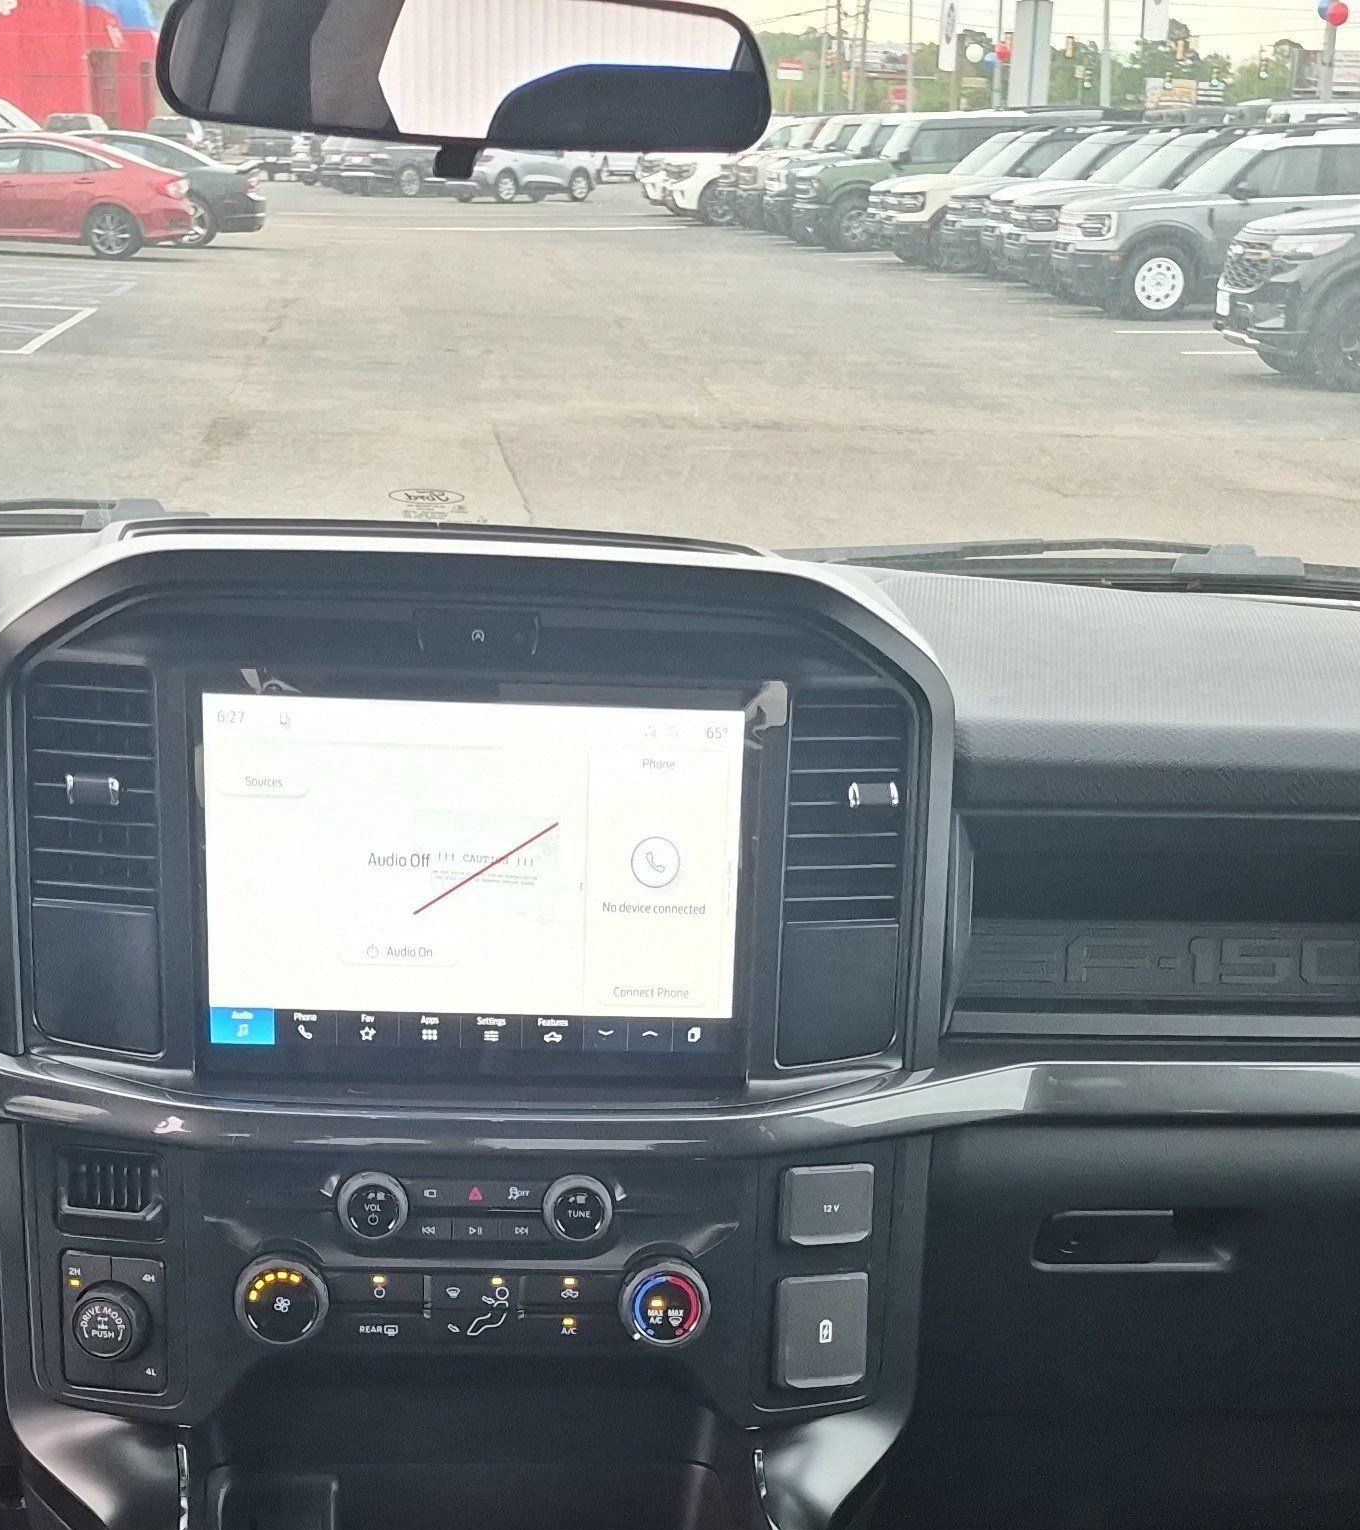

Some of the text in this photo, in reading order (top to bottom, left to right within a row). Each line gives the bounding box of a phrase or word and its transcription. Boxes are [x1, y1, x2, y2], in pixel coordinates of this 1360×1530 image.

[217, 710, 245, 724] 6:27
[706, 727, 729, 740] 65°
[642, 758, 676, 770] Phone
[245, 775, 283, 788] Sources
[368, 853, 431, 868] Audio Off
[602, 901, 706, 915] No device connected
[386, 946, 433, 958] Audio On
[613, 986, 690, 999] Connect Phone
[231, 1010, 254, 1020] Audio
[293, 1011, 318, 1022] Phone
[360, 1013, 375, 1023] Fav
[420, 1015, 440, 1026] Apps
[476, 1016, 507, 1028] Settings
[537, 1017, 569, 1028] Features
[364, 1203, 382, 1212] VOL
[823, 1204, 840, 1213] 12 V
[567, 1209, 591, 1218] TUNE
[68, 1267, 81, 1276] 2H
[142, 1273, 155, 1283] 4H
[80, 1306, 126, 1330] DRIVE MODE
[647, 1309, 663, 1317] MAX
[667, 1309, 684, 1317] MAX
[649, 1317, 663, 1325] A/C
[91, 1329, 115, 1339] PUSH
[359, 1325, 383, 1334] REAR
[561, 1327, 578, 1335] A/C
[145, 1367, 156, 1376] 4L
